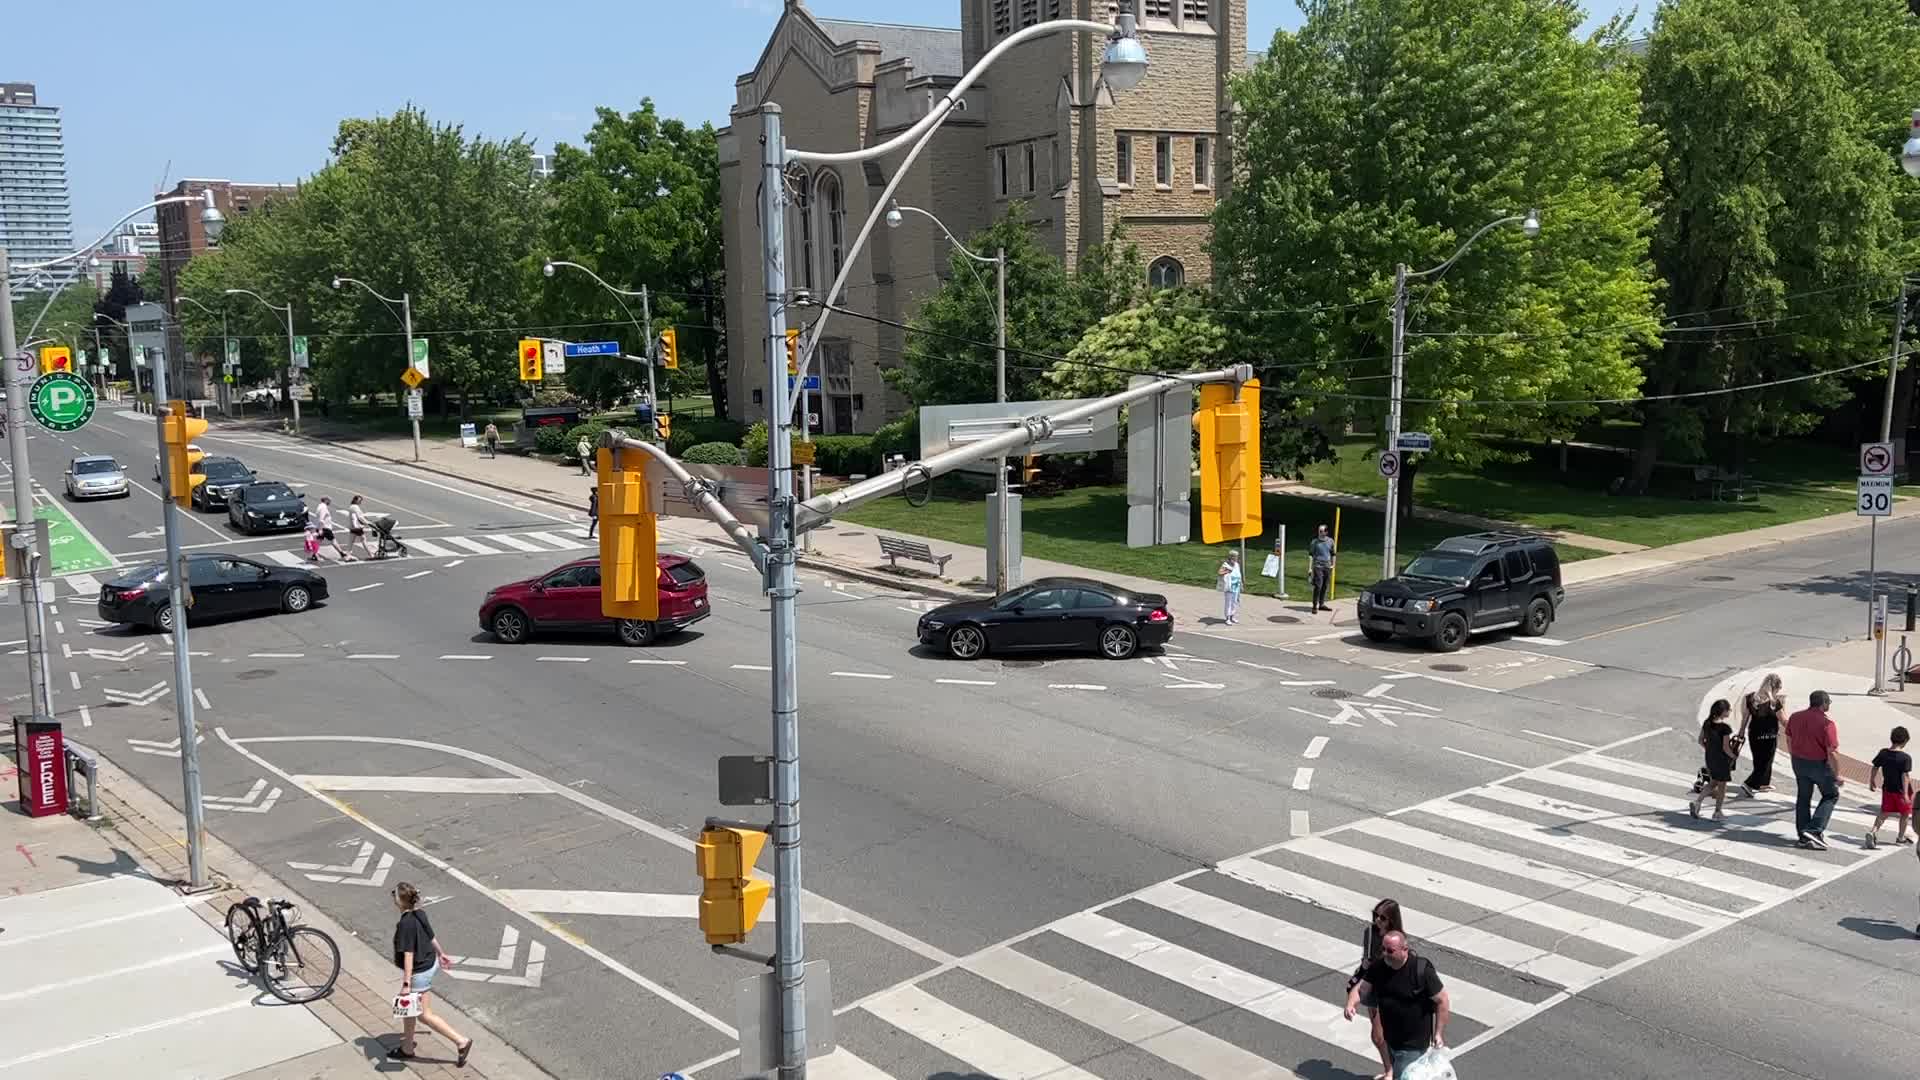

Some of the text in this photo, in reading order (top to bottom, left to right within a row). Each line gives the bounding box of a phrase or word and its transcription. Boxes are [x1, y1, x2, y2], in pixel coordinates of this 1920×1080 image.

[577, 344, 600, 354] Heath
[31, 373, 92, 401] MUNICIPAL
[50, 387, 76, 412] P
[33, 405, 93, 430] PARKING
[1860, 480, 1890, 488] MAXIMUM
[1860, 493, 1889, 511] 30
[40, 760, 56, 806] FREE
